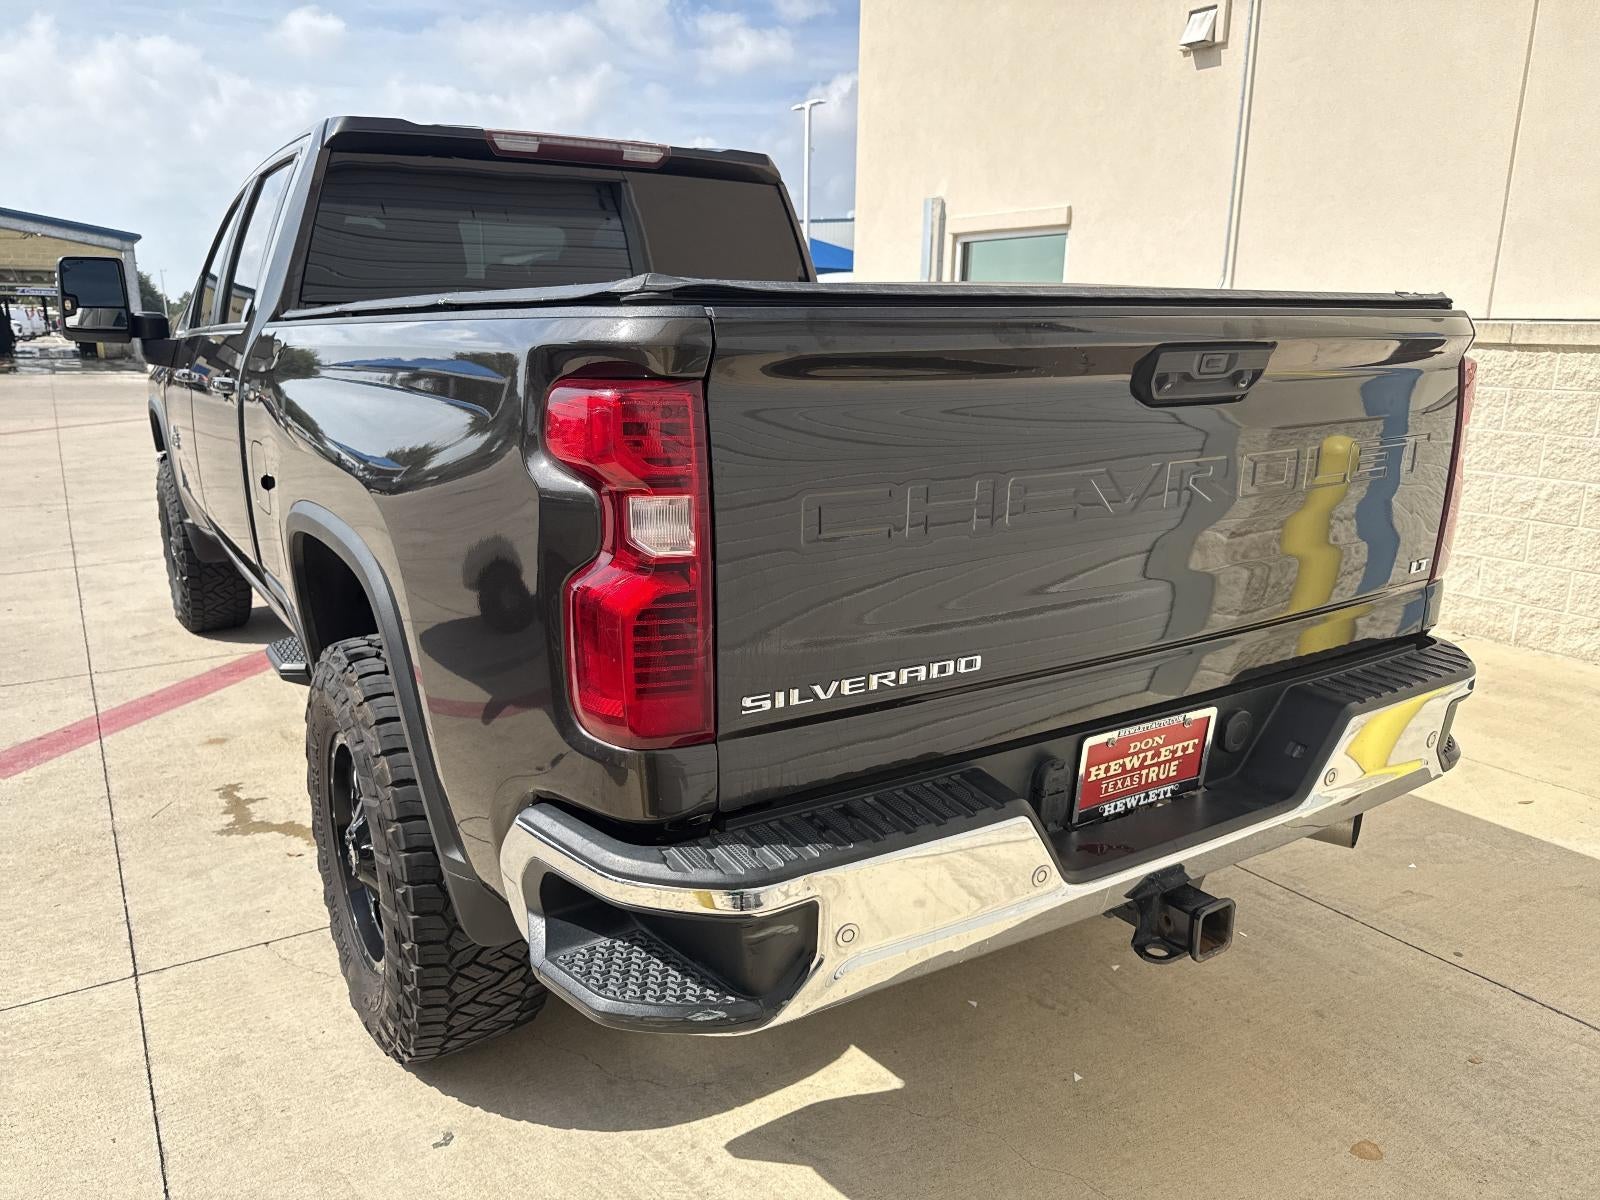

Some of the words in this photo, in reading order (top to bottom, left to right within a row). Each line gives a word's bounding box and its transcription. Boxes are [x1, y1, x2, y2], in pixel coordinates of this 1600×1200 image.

[801, 432, 1432, 545] CHEVROLET
[1409, 558, 1430, 574] LT
[741, 654, 982, 715] SILVERADO
[1087, 738, 1199, 782] HEWLETT
[1128, 734, 1166, 754] DON
[1102, 785, 1174, 817] HEWLETT
